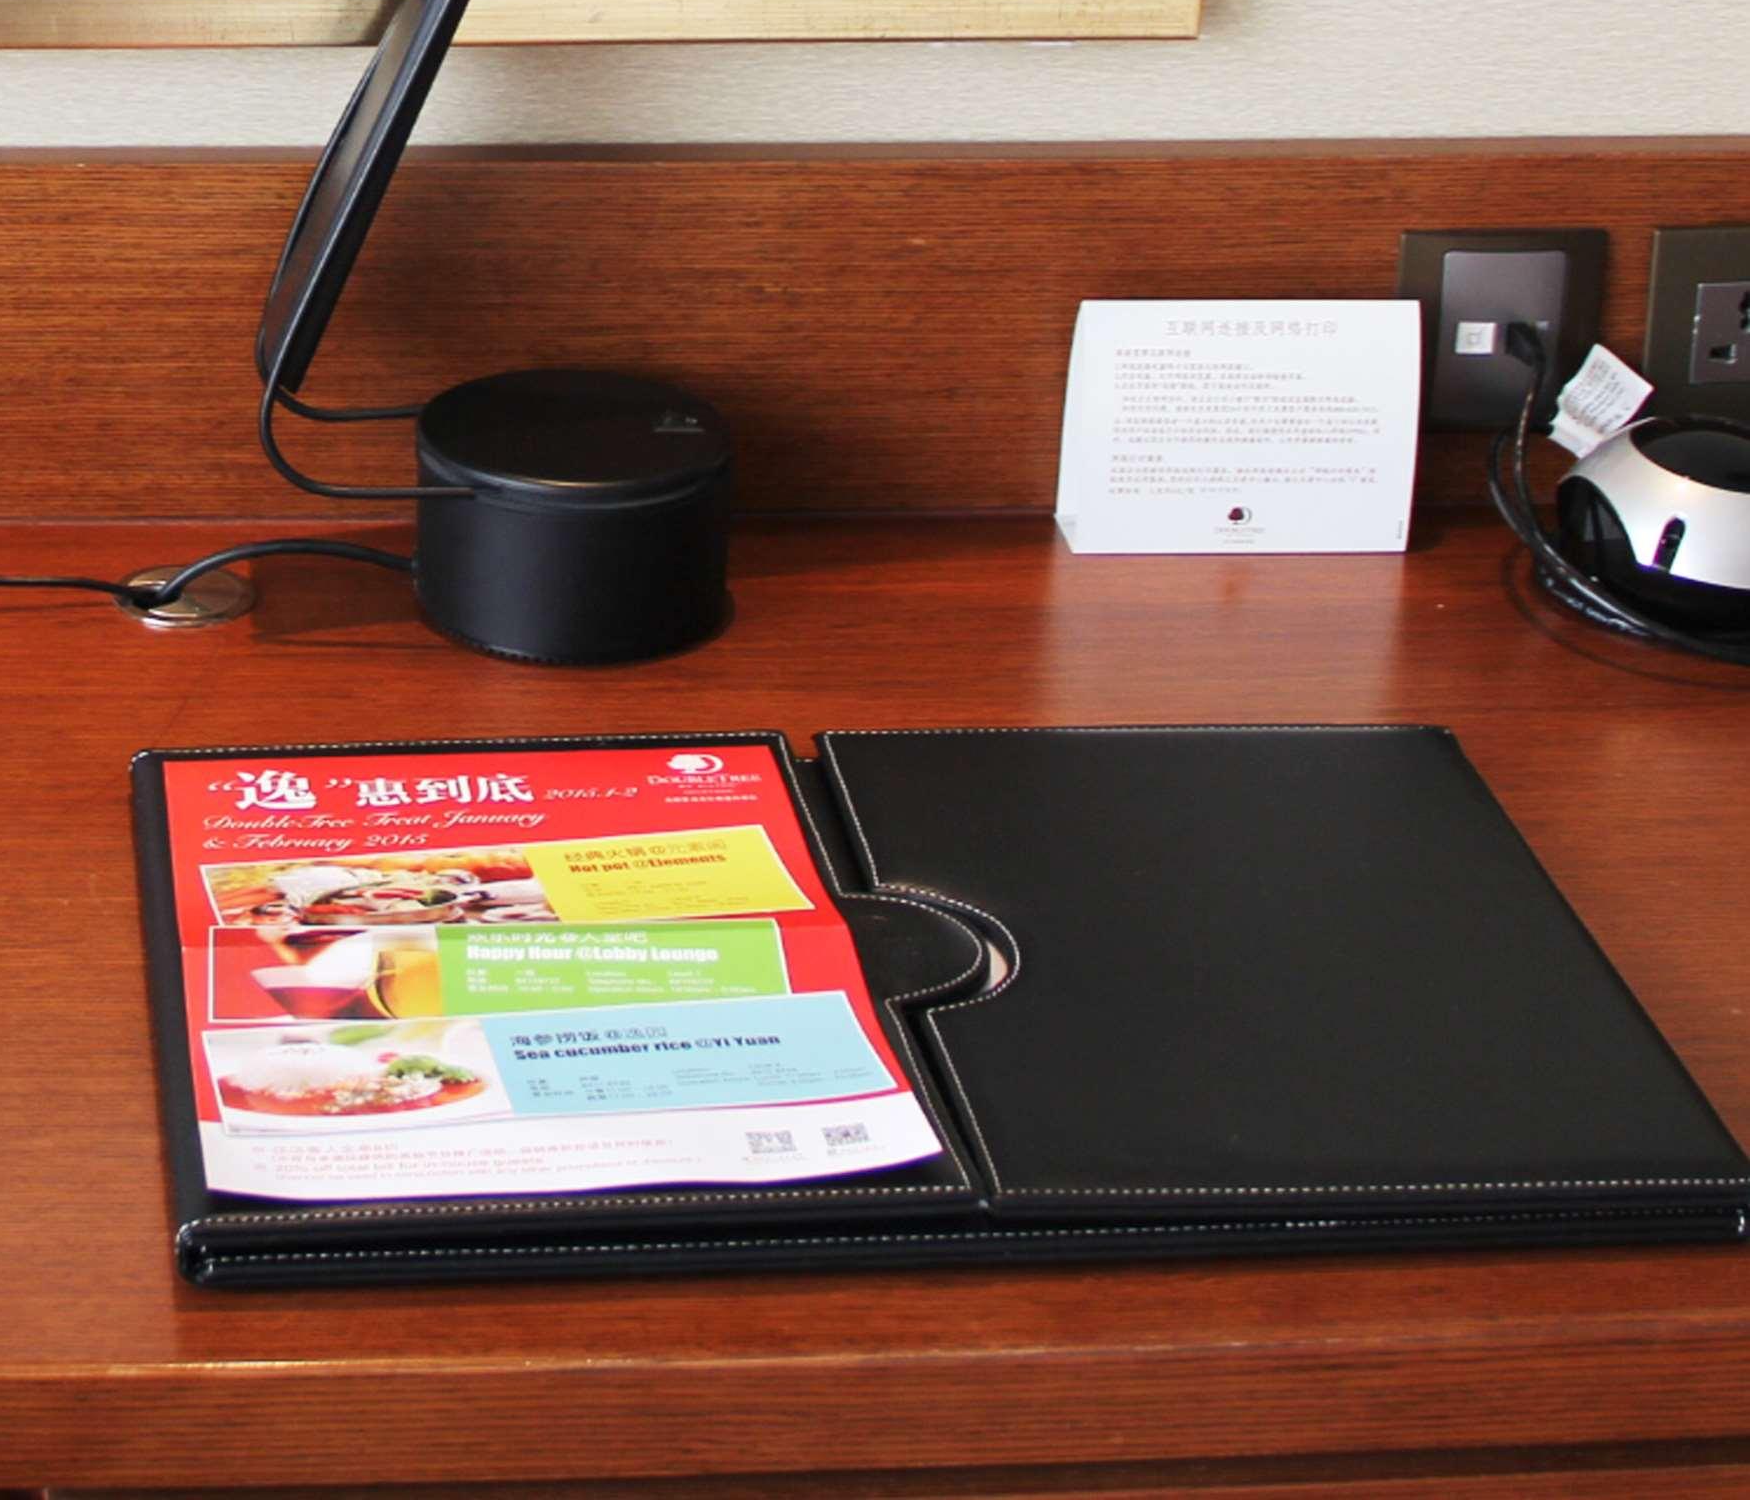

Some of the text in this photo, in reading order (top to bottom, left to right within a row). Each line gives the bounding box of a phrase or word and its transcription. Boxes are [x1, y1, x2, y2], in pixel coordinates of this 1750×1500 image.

[432, 808, 546, 829] January
[233, 833, 353, 852] February
[364, 833, 429, 847] 2015
[467, 945, 525, 962] Happy
[528, 945, 571, 960] Hour
[651, 948, 719, 963] Lounge
[513, 1048, 550, 1060] Sea
[554, 1042, 649, 1059] cucumber
[654, 1039, 692, 1053] rice
[734, 1034, 781, 1048] Yuan
